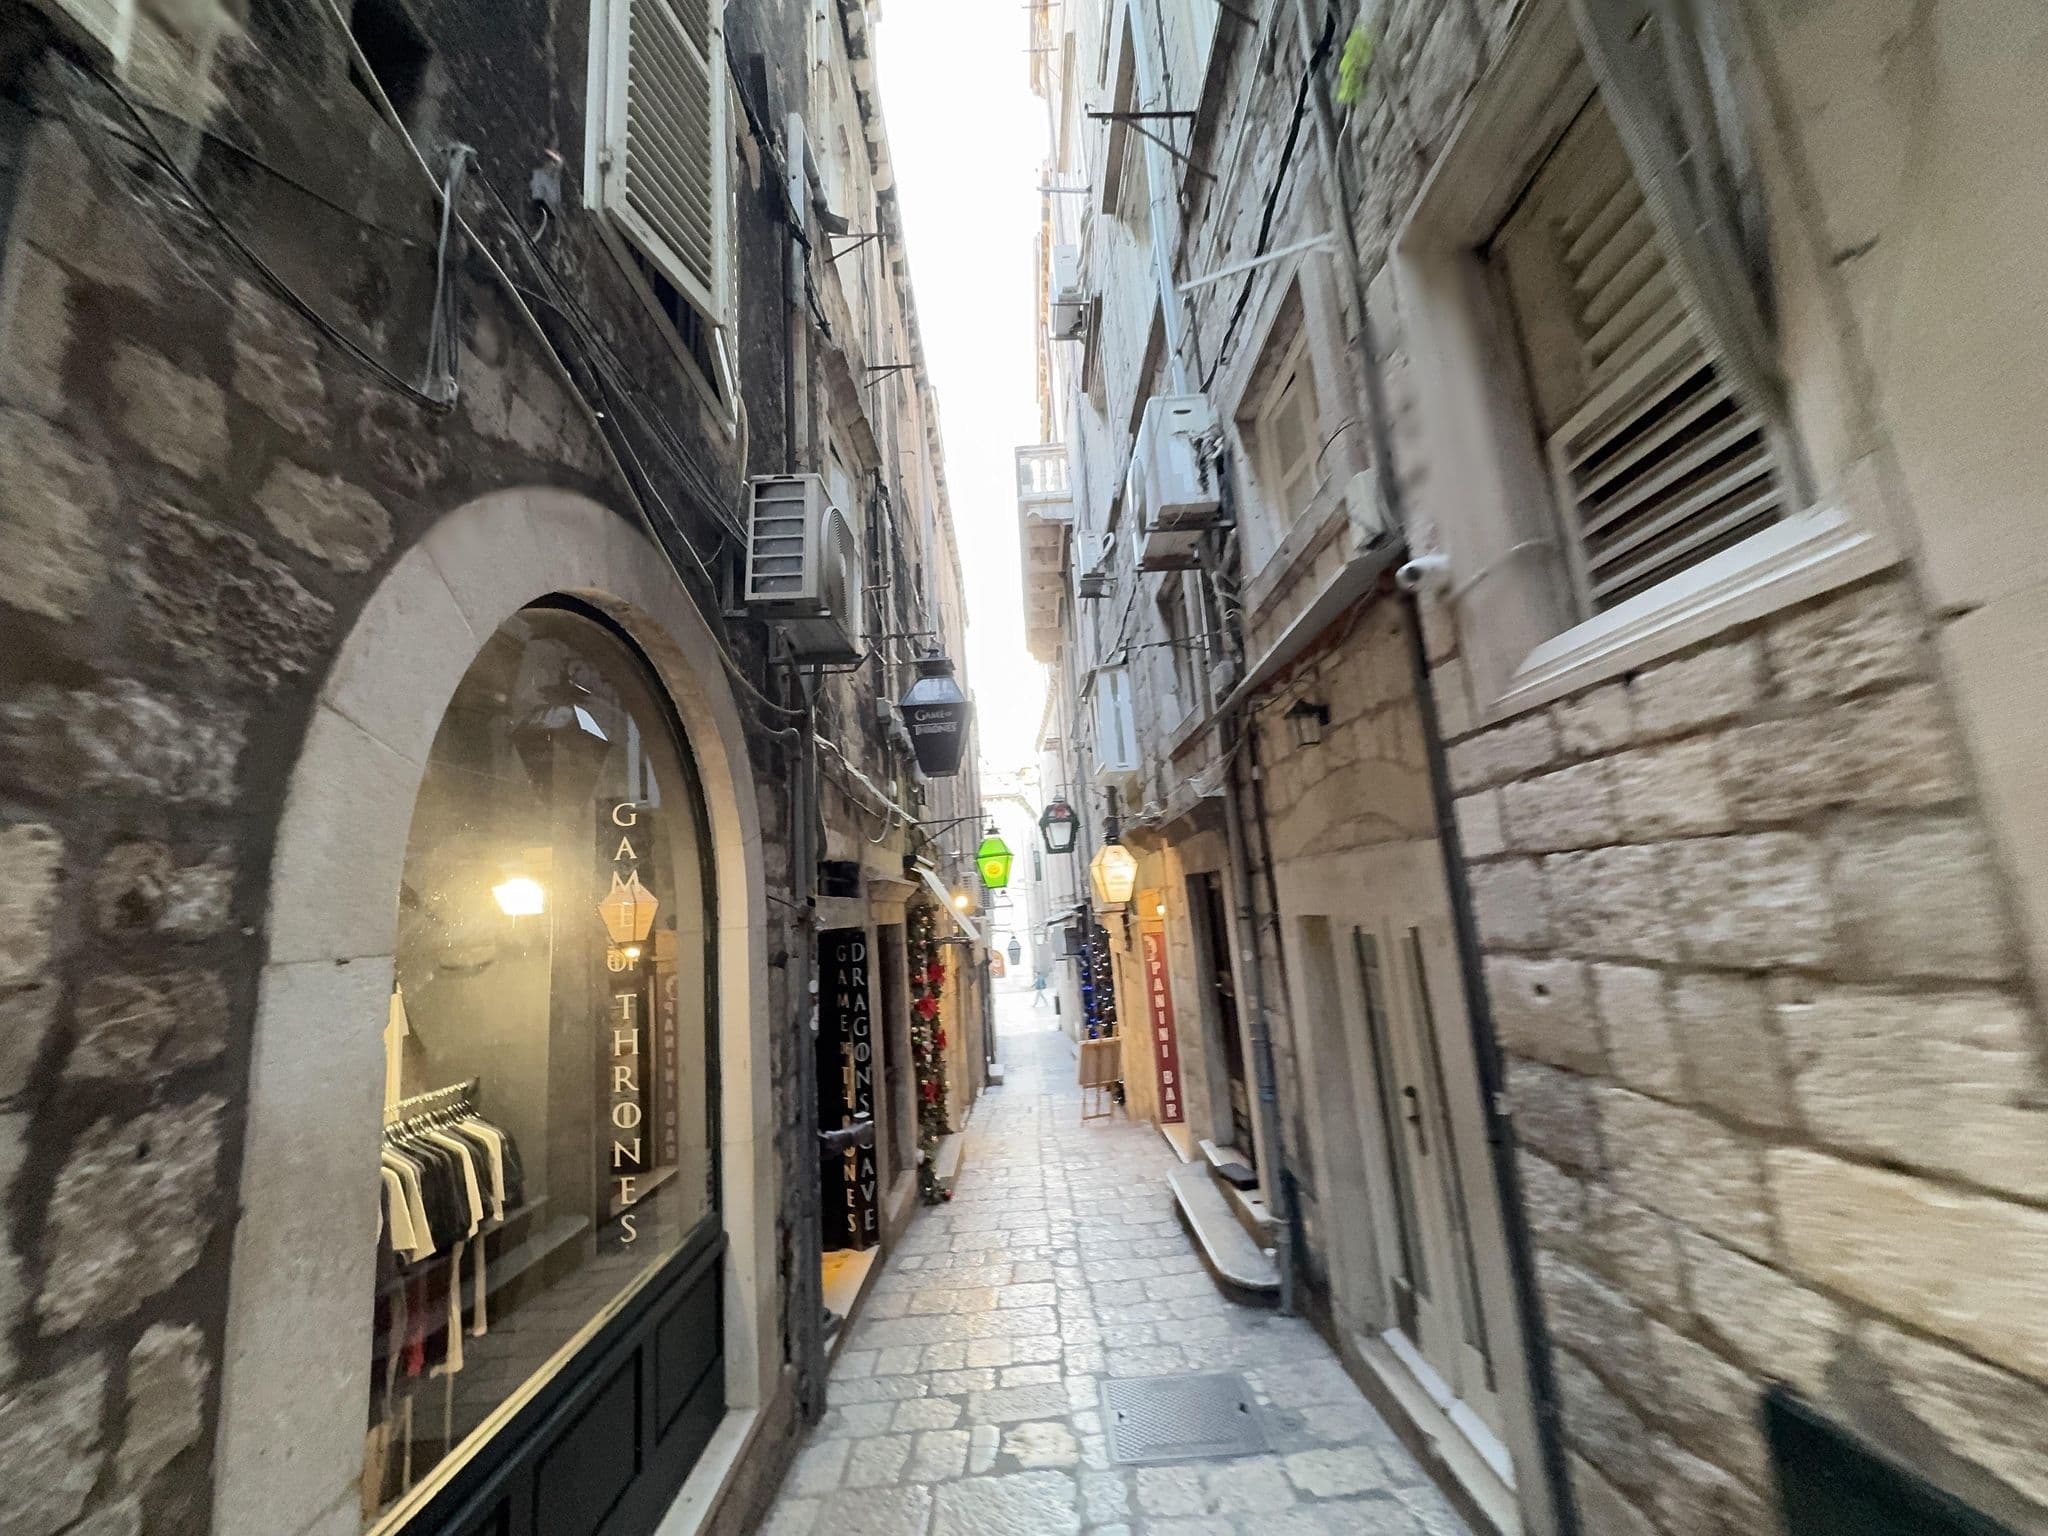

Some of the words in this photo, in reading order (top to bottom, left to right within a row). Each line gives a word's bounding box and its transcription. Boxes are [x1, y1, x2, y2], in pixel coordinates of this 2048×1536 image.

[611, 802, 642, 928] GAME
[836, 944, 850, 1032] GAME
[851, 942, 872, 1112] DRAGONS
[1151, 961, 1169, 1058] PANINI
[1162, 1070, 1178, 1118] BAR
[612, 993, 642, 1243] THRONES
[859, 1143, 876, 1231] AVE
